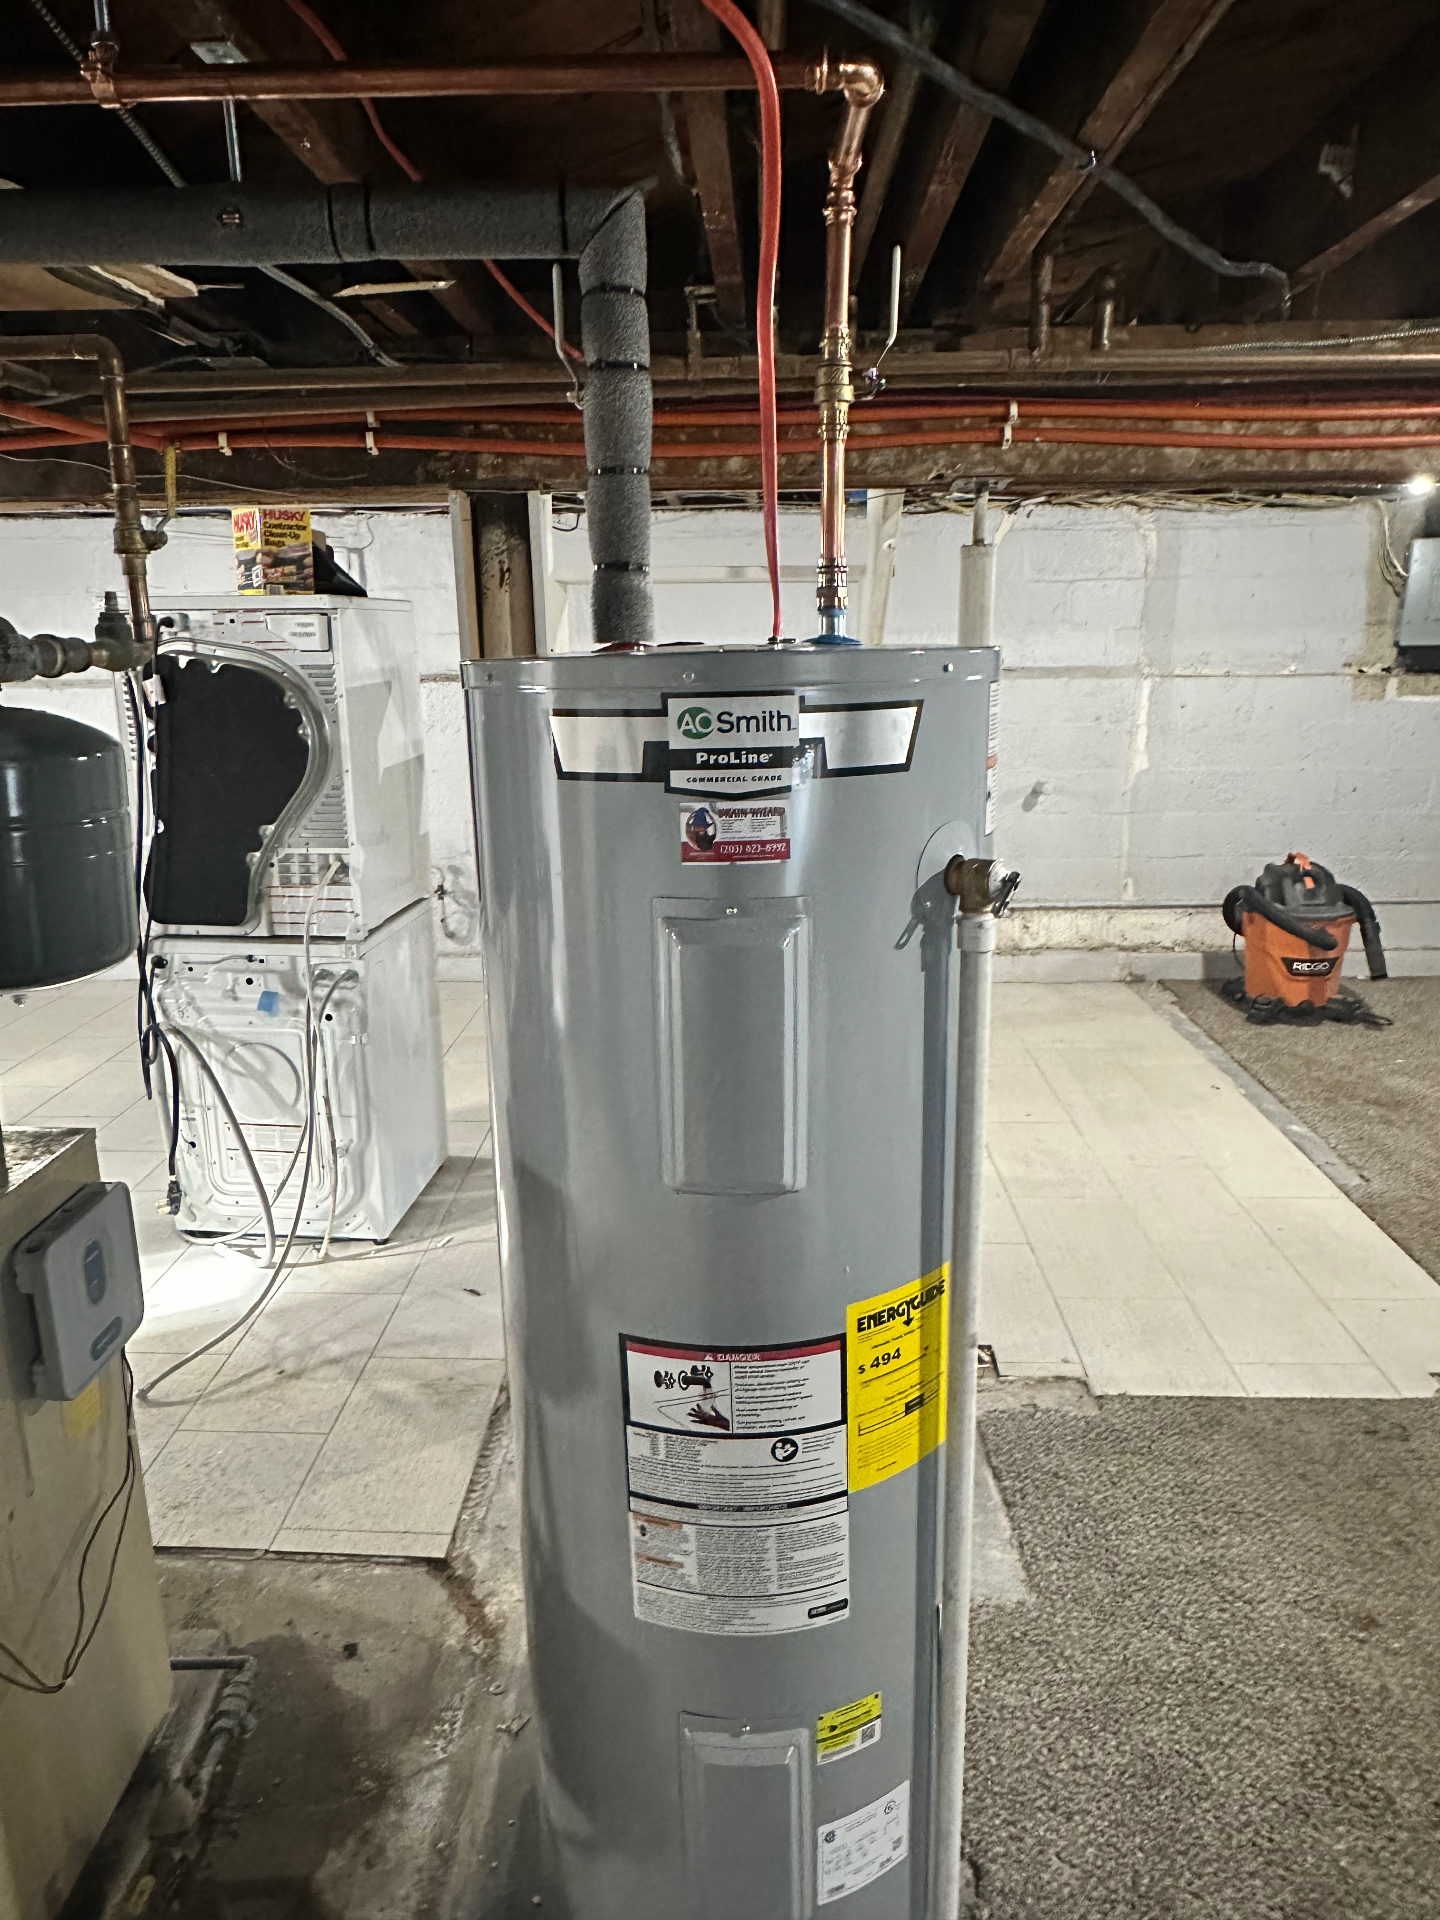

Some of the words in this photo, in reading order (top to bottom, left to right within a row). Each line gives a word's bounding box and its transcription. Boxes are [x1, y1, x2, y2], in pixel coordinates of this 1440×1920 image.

[262, 508, 306, 521] HUSKY
[716, 709, 792, 733] Smith
[695, 750, 770, 765] ProLine
[869, 1346, 902, 1369] 494
